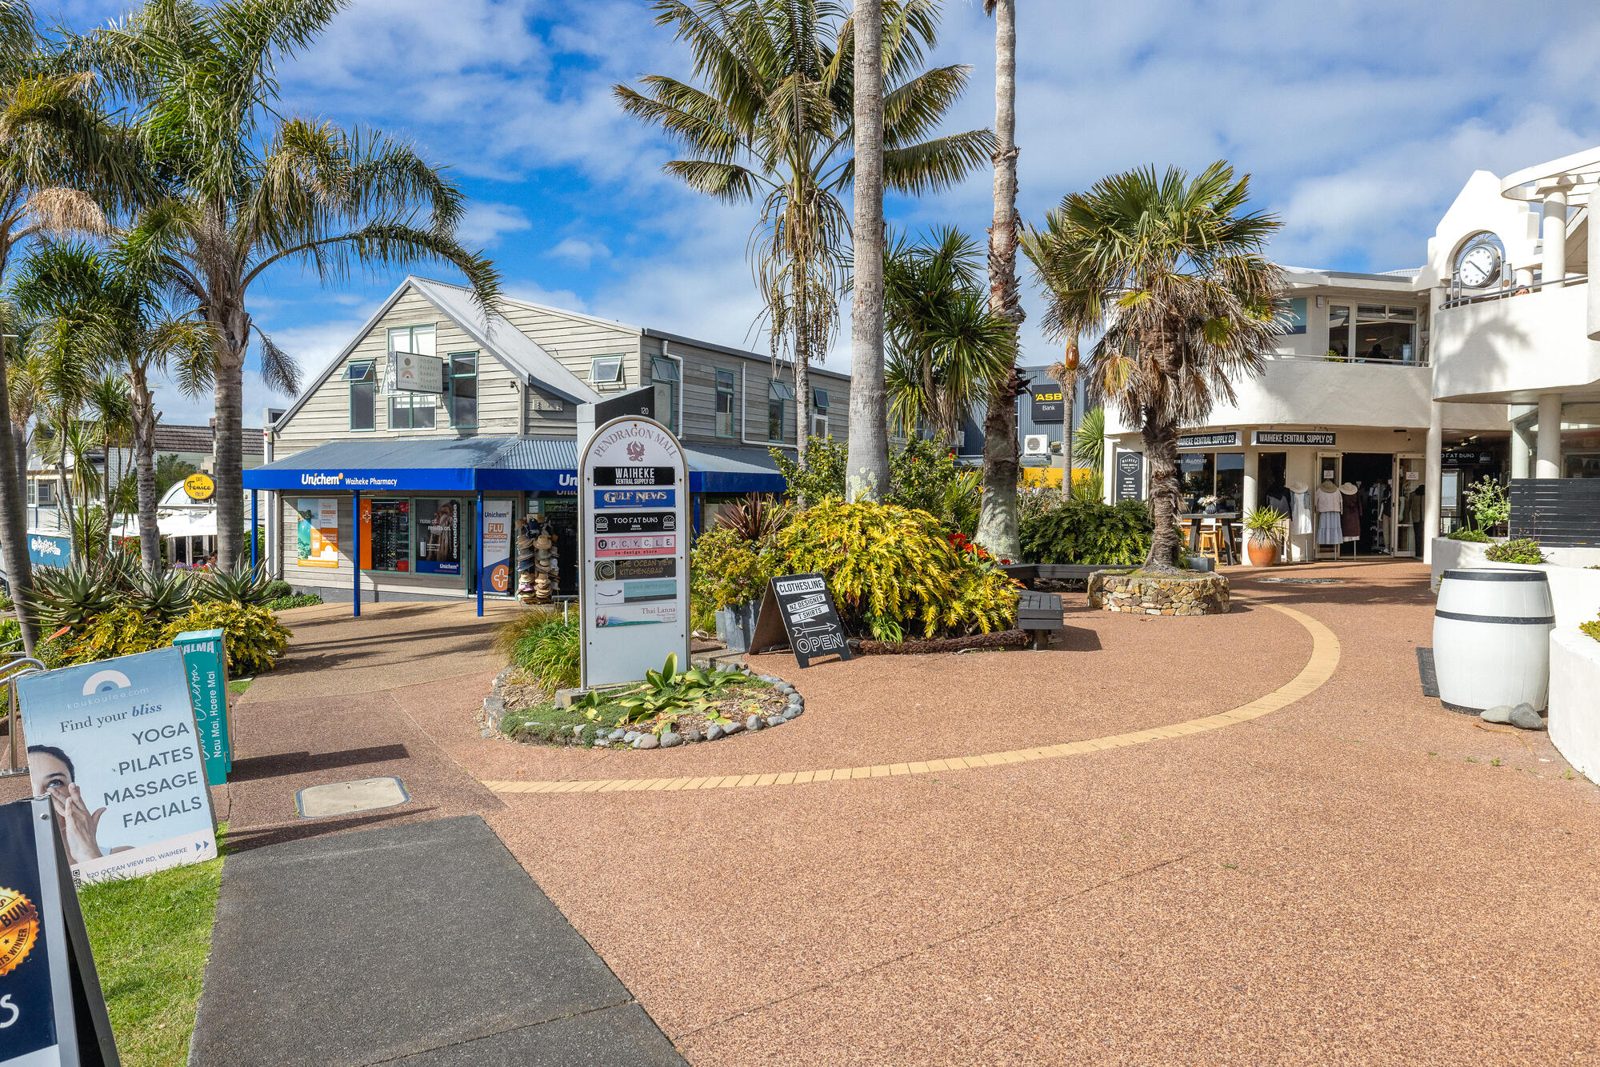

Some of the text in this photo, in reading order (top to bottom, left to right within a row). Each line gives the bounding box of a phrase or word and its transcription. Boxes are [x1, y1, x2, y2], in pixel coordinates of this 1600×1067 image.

[1036, 393, 1062, 401] ASB
[594, 427, 678, 458] PENDRAGON MALL
[1194, 436, 1211, 445] CENTRAL
[1212, 435, 1227, 444] SUPPLY
[1260, 434, 1282, 442] WAIHEKE
[1284, 434, 1305, 443] CENTRAL
[1307, 435, 1325, 443] SUPPLY
[301, 473, 397, 487] Unichem Waiheke Pharmacy
[615, 468, 655, 478] WAIHEKE
[604, 491, 667, 503] GULF NEWS
[489, 523, 503, 533] FLU
[779, 580, 824, 593] CLOTHESLINE
[797, 596, 824, 608] DESIGNER
[804, 607, 822, 618] SHIRTS
[183, 641, 215, 655] ALMA
[796, 633, 844, 654] OPEN
[60, 703, 163, 733] Find your bliss
[206, 671, 222, 758] Nau Mai, Haere Mai
[132, 722, 190, 745] YOGA
[118, 746, 194, 775] PILATES
[104, 771, 199, 806] MASSAGE
[123, 796, 202, 828] FACIALS
[101, 864, 126, 876] OCEAN
[127, 859, 144, 868] VIEW
[158, 847, 188, 860] WAIHEKE
[8, 928, 28, 958] WINNER
